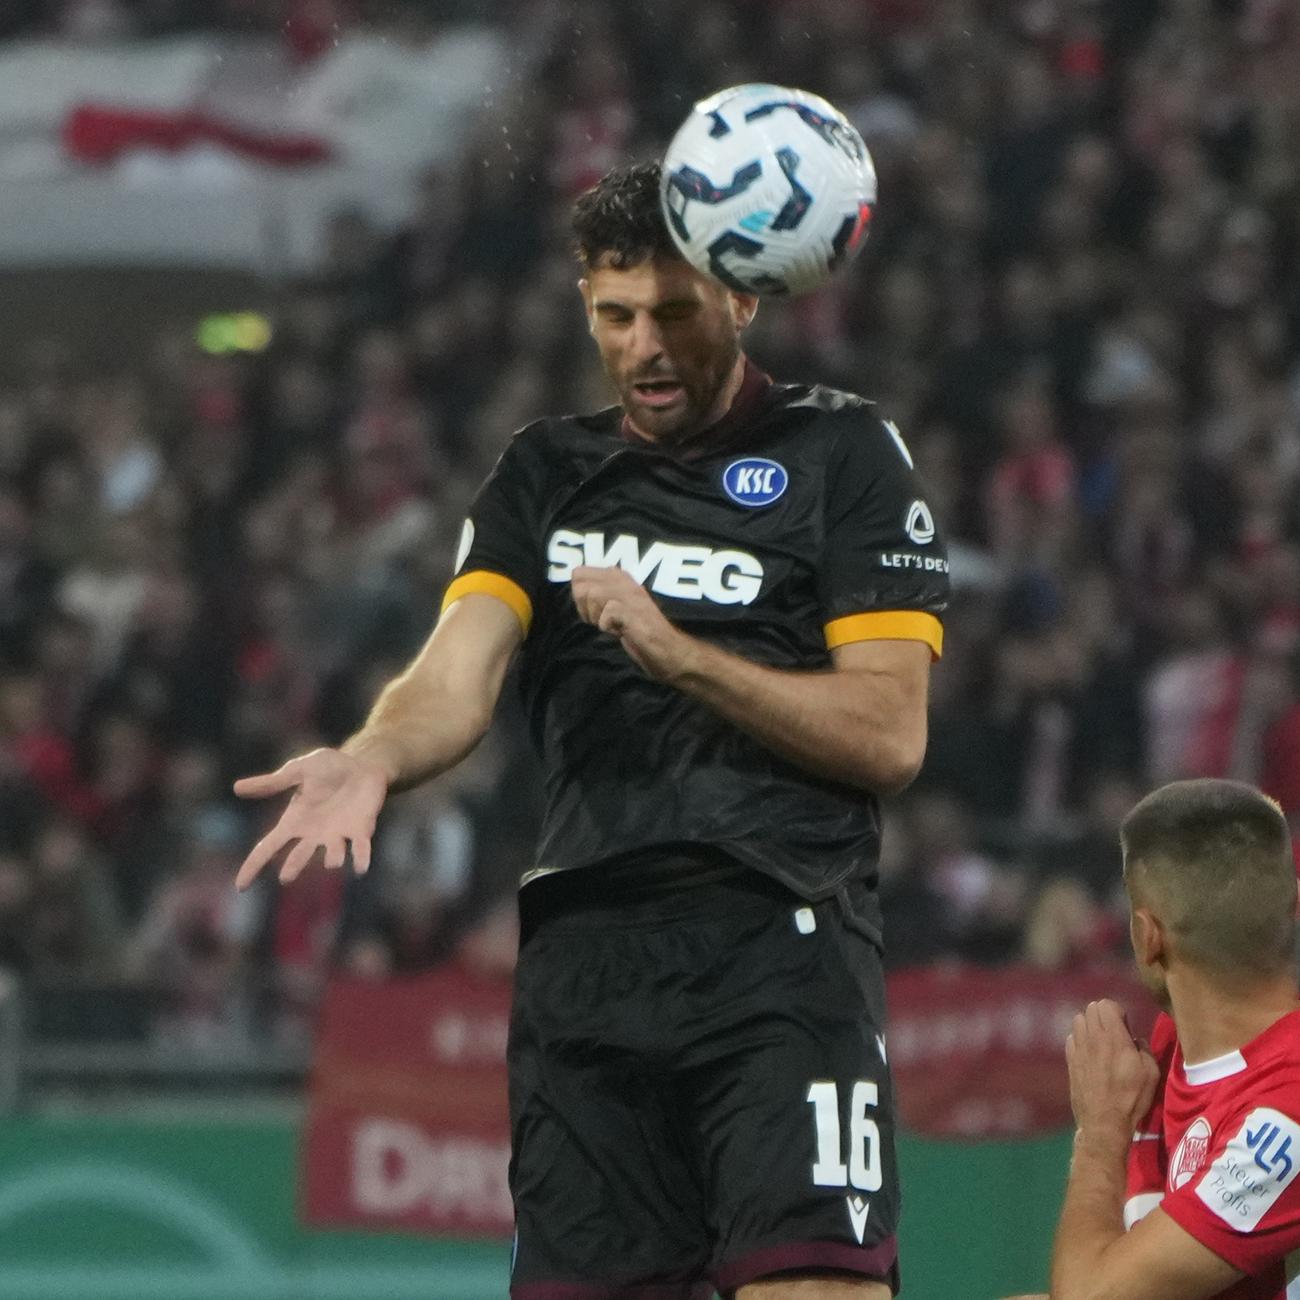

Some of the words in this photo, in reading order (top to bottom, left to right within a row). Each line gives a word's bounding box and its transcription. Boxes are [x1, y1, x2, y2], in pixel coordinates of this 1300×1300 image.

[736, 468, 776, 494] KSC
[547, 529, 764, 606] SWEG
[881, 554, 923, 568] LET'S
[806, 1081, 883, 1192] 16
[1210, 1175, 1249, 1217] Profis
[1221, 1156, 1271, 1198] Steuer
